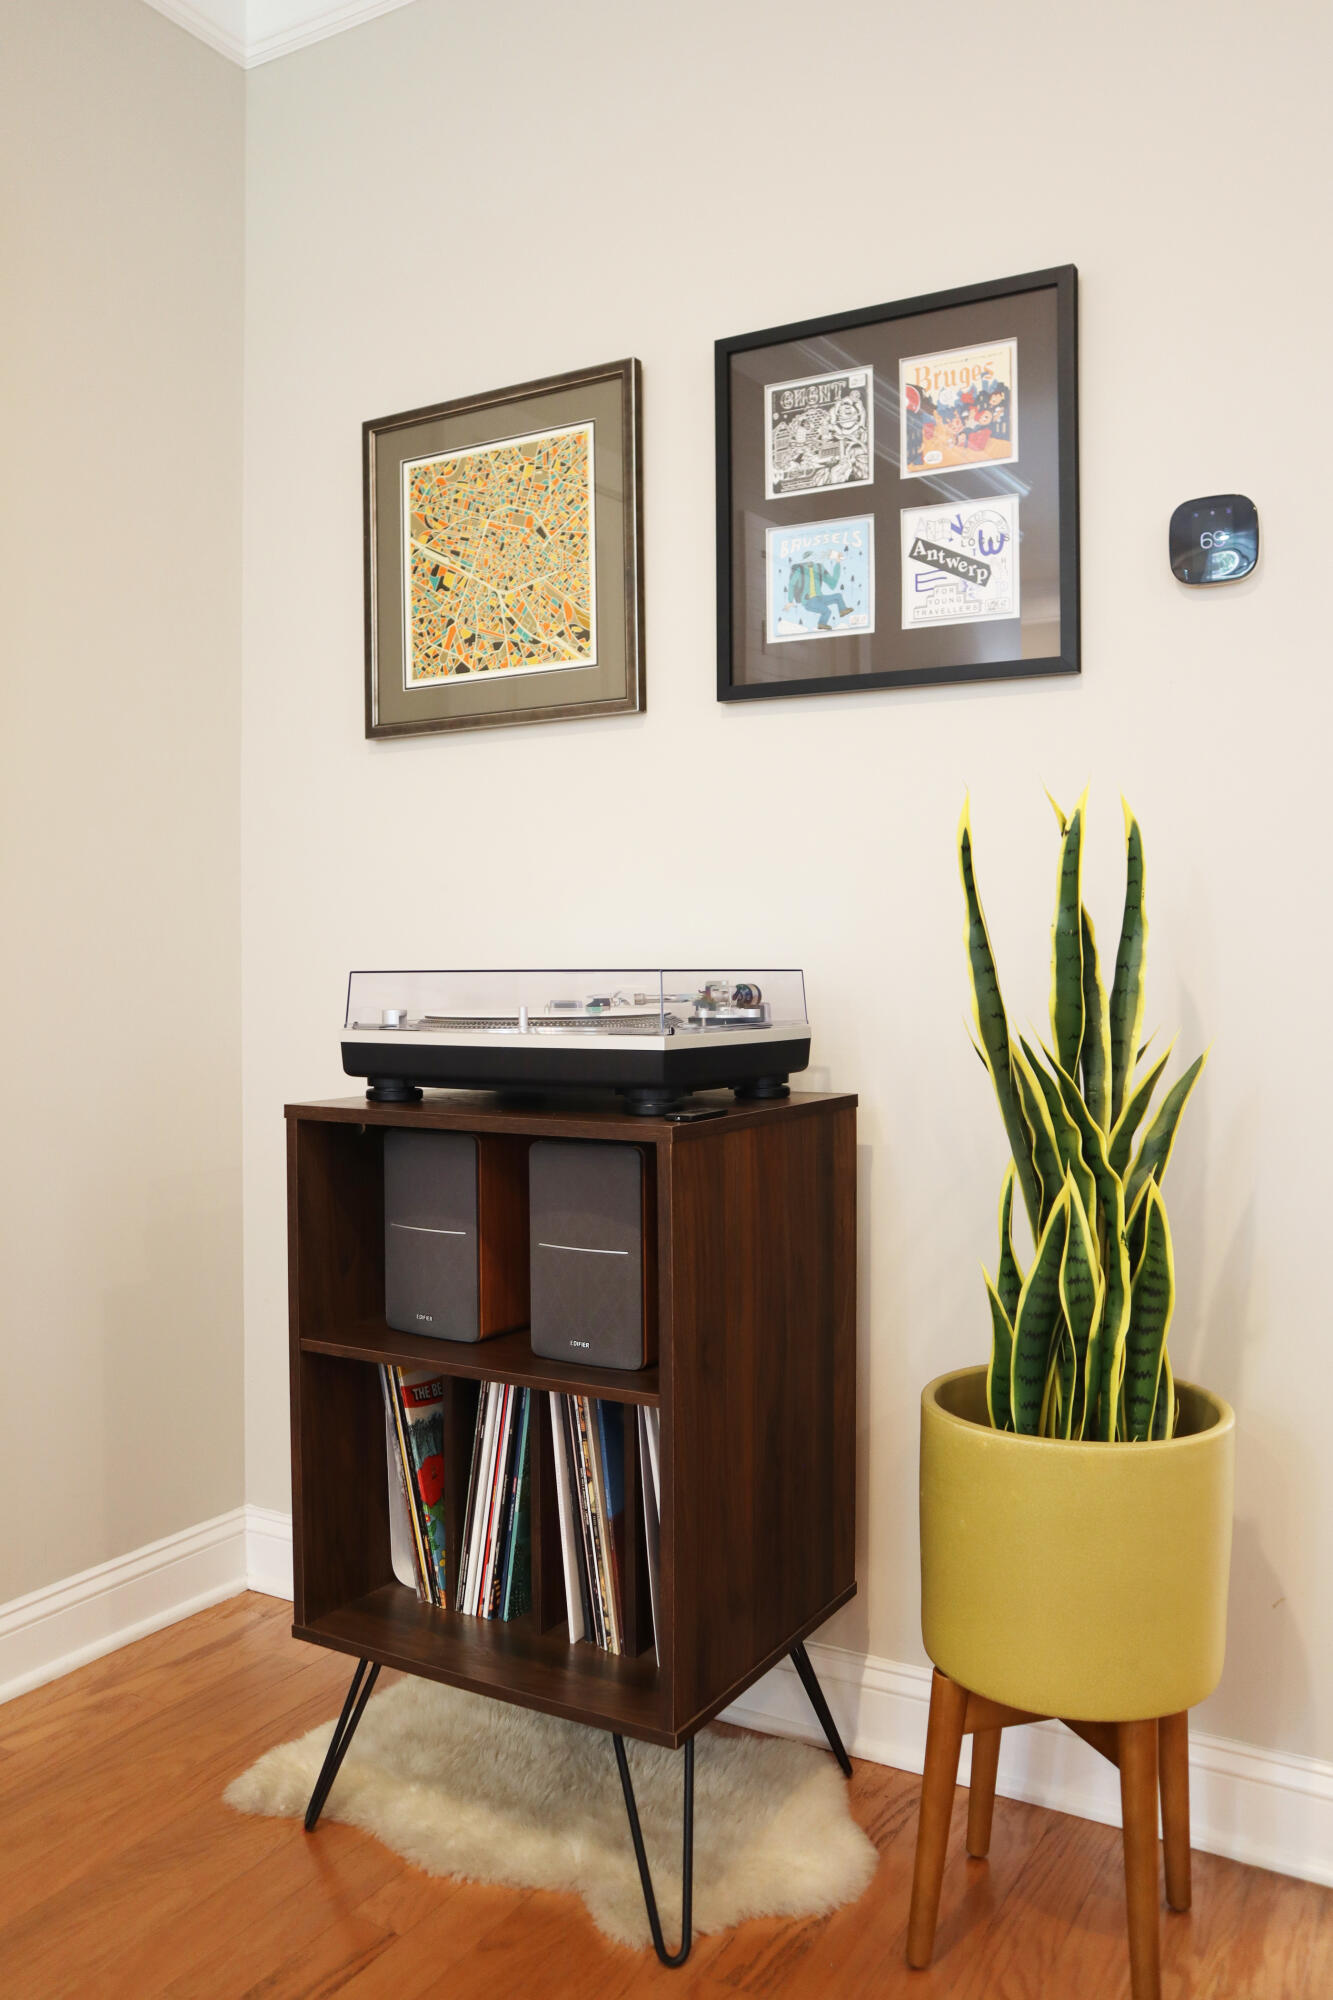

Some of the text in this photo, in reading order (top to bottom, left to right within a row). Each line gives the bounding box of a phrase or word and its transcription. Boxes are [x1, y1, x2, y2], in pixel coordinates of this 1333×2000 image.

[915, 361, 994, 392] Bruges
[780, 530, 862, 558] BRUSSELS
[912, 540, 989, 584] Antwerp
[412, 1386, 431, 1401] THE
